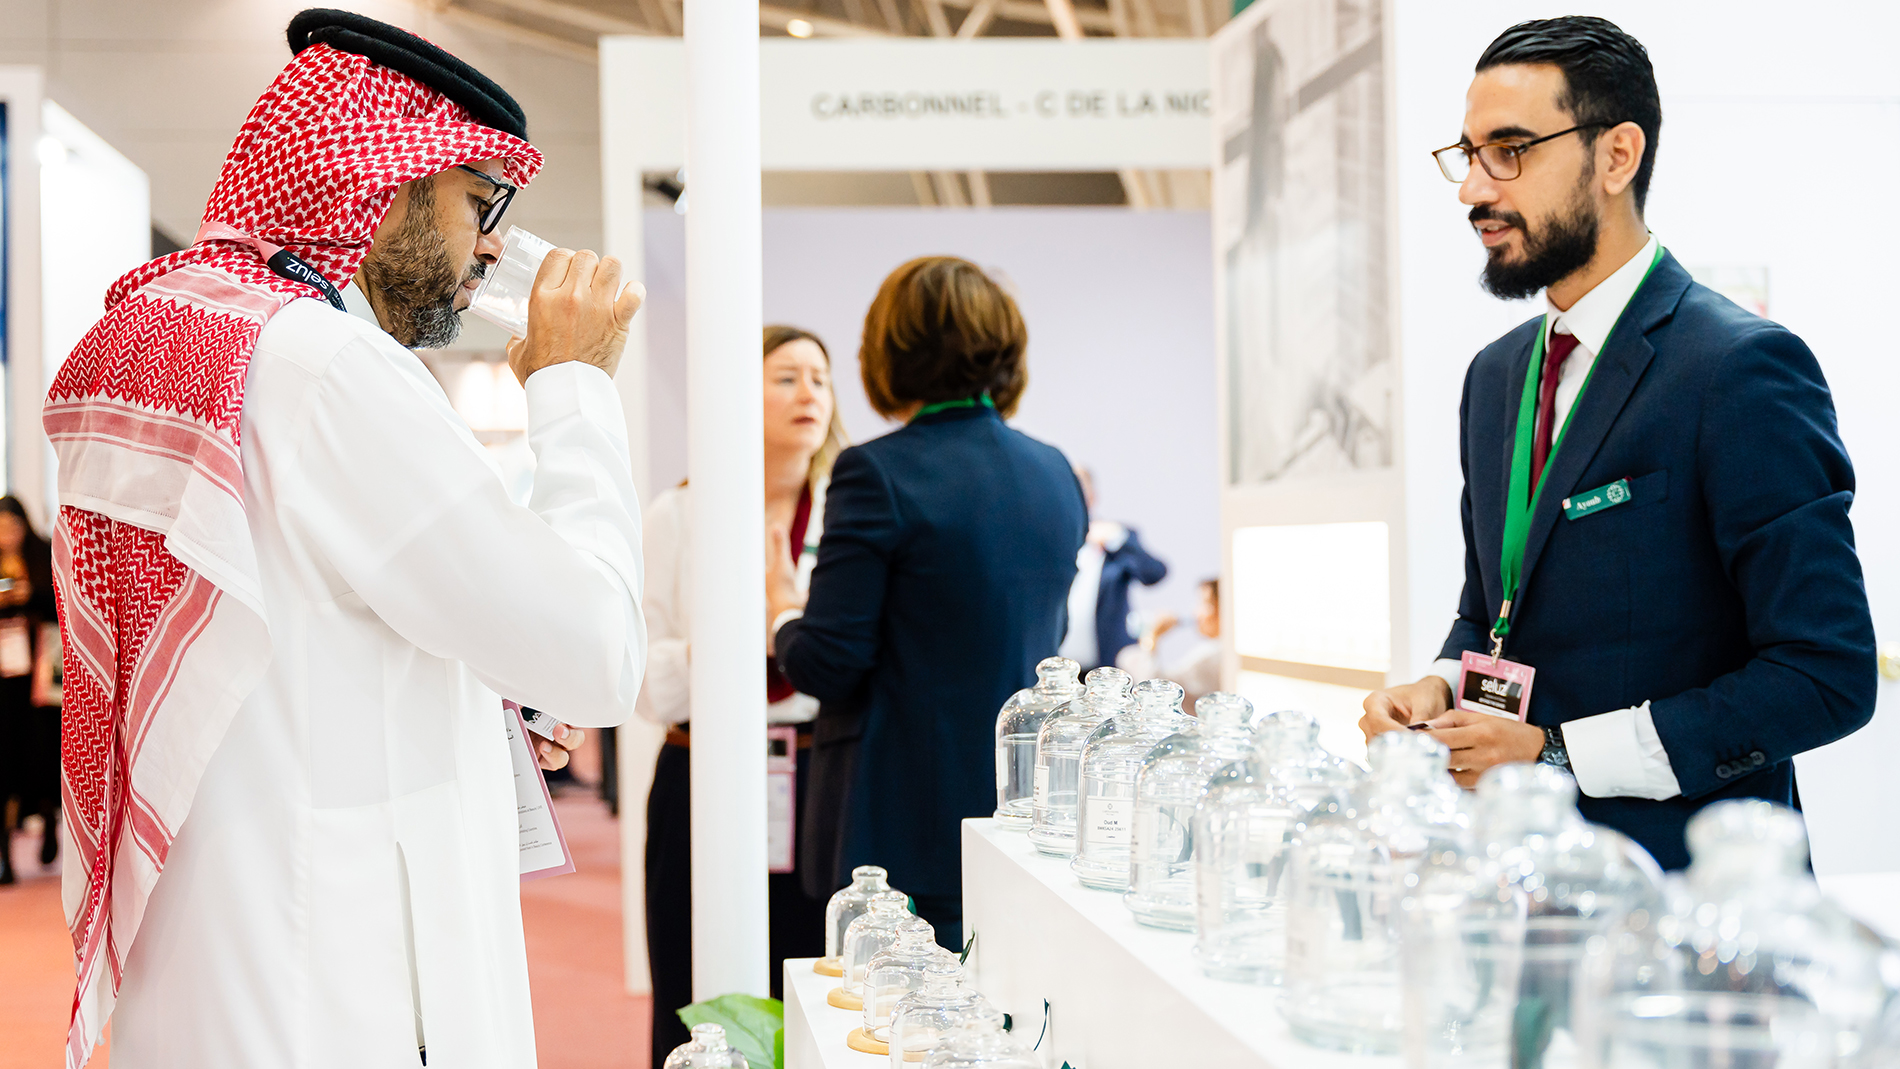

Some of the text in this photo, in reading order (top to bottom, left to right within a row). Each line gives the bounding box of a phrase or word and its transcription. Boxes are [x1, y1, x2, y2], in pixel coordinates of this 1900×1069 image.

[810, 90, 1007, 120] CARBONNEL
[1034, 90, 1059, 119] C
[1064, 90, 1108, 118] DE
[1115, 90, 1160, 118] LA
[285, 258, 330, 290] seluz
[1480, 678, 1508, 697] seluz
